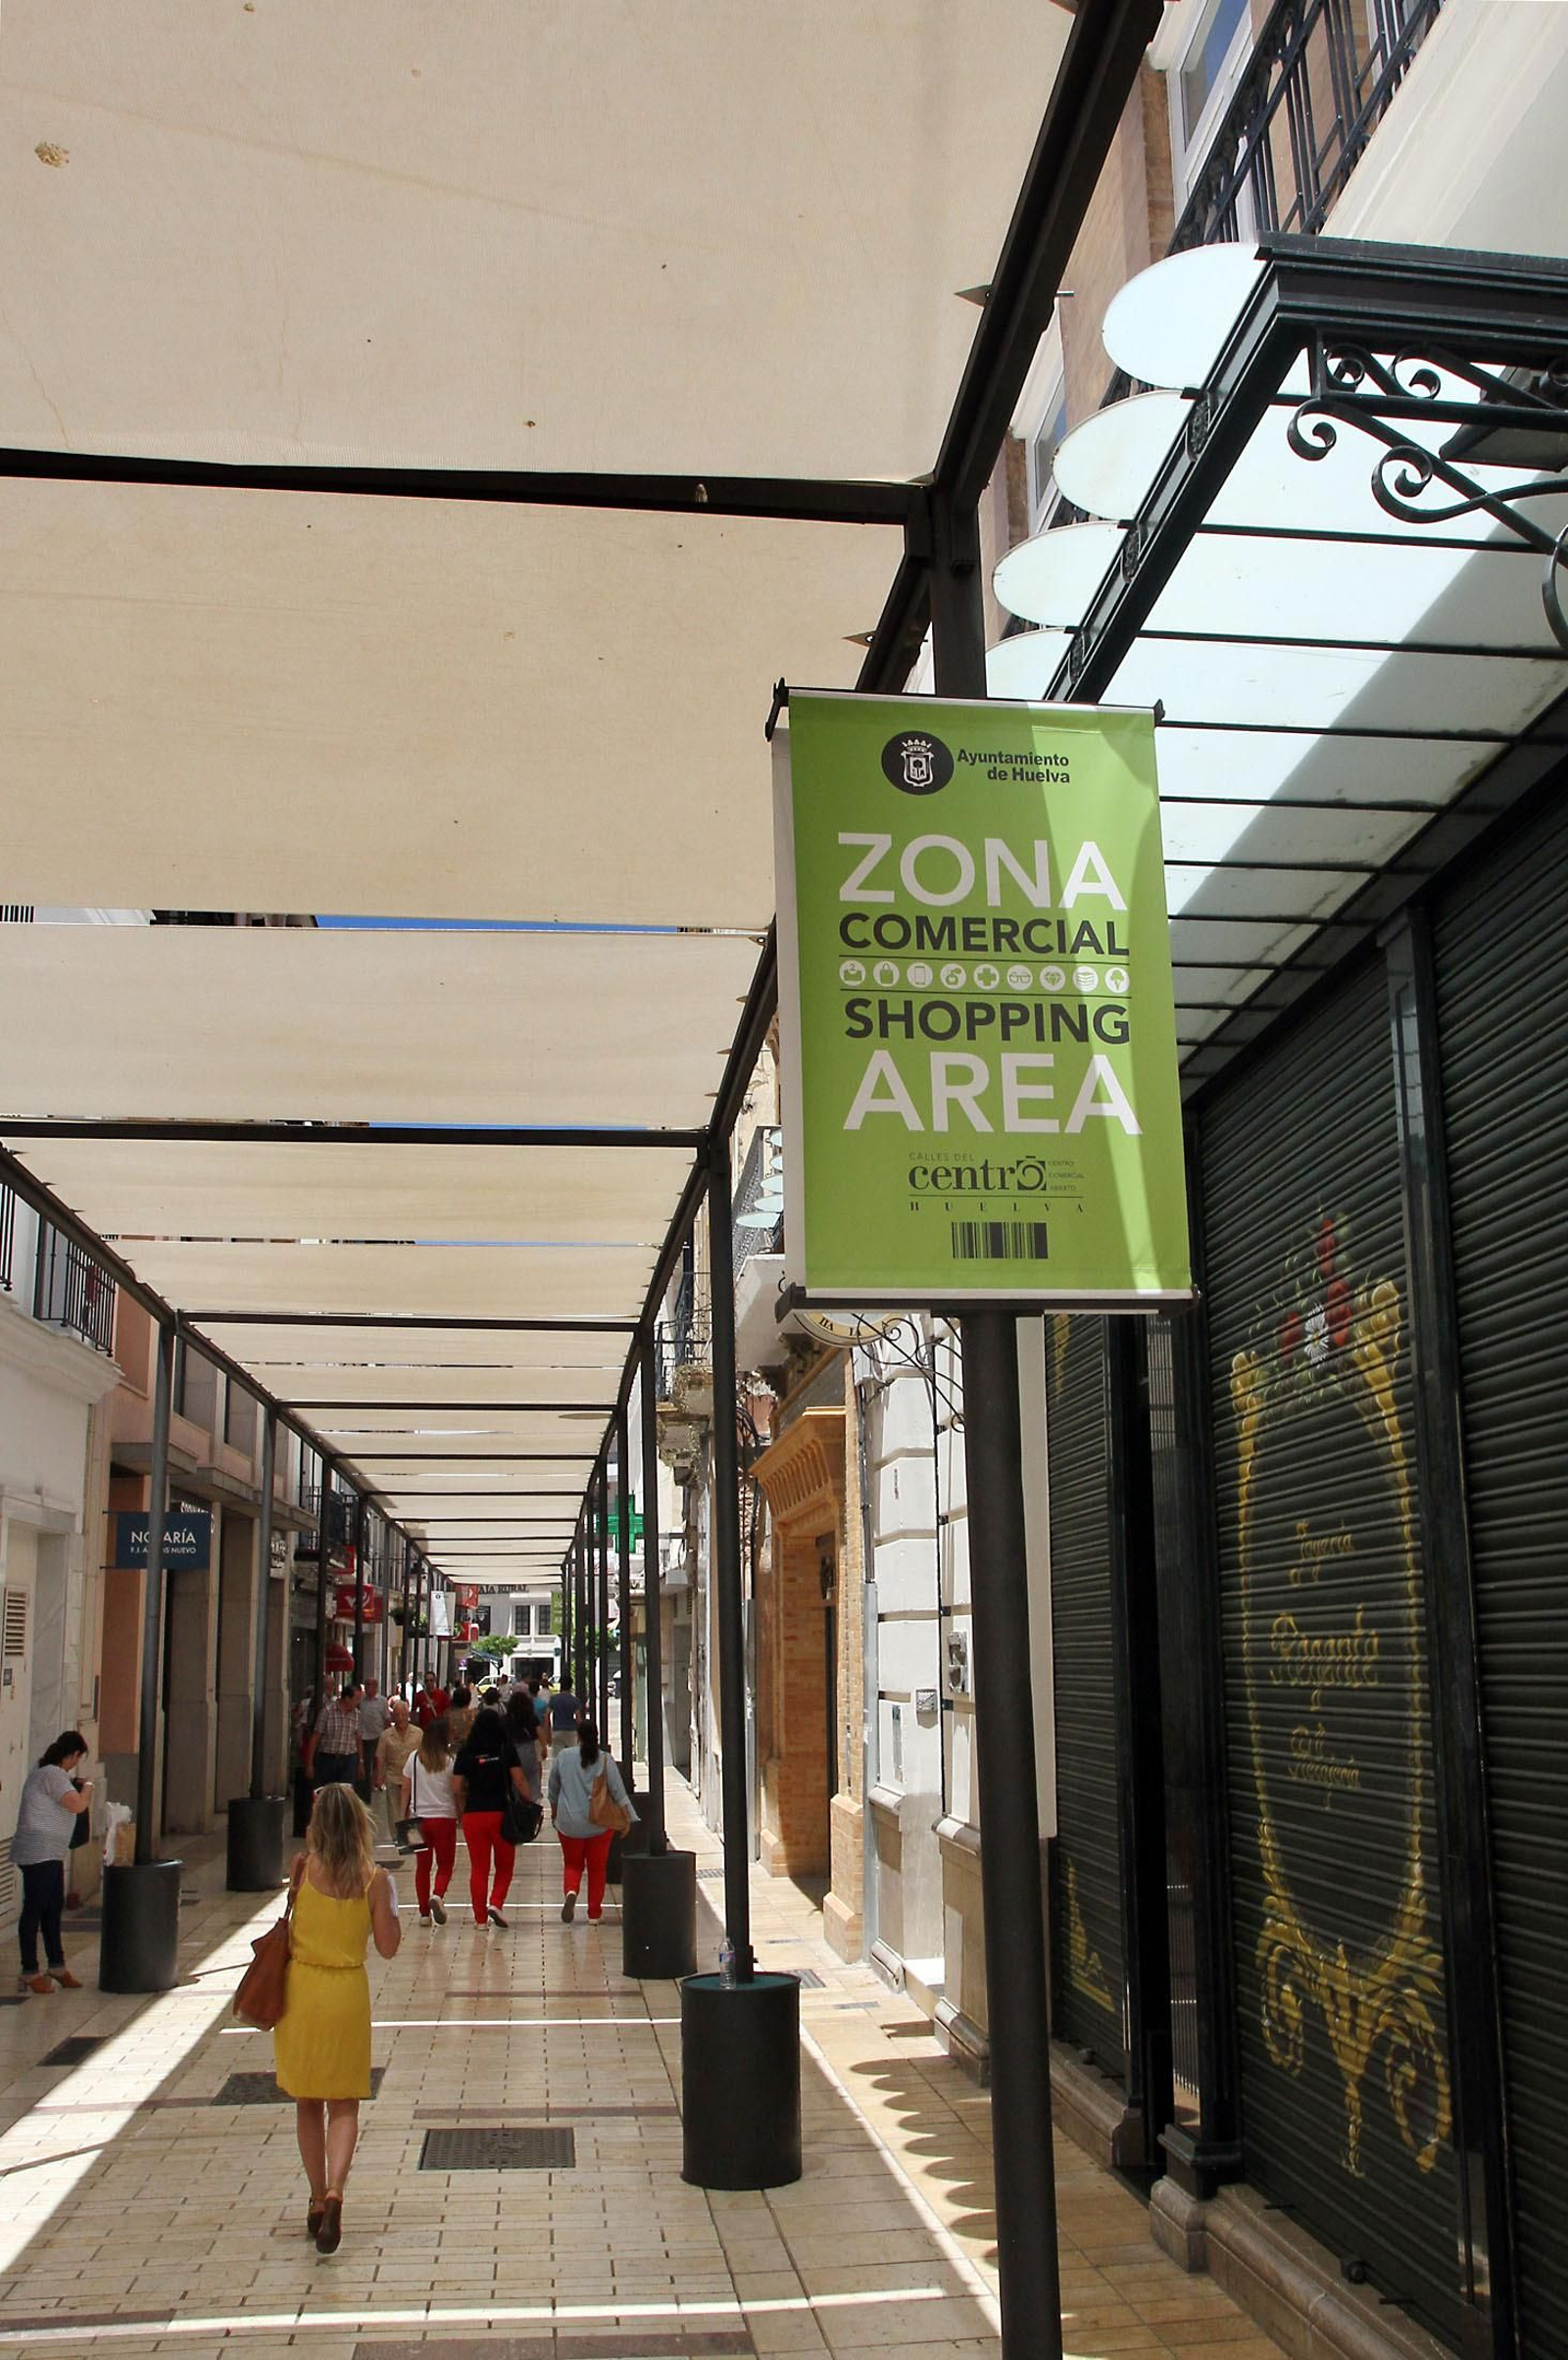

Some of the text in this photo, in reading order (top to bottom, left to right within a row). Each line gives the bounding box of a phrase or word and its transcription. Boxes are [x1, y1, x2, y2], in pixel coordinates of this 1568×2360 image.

[956, 749, 1070, 767] Ayuntamiento
[987, 766, 1071, 784] de Huelva
[838, 831, 1128, 910] ZONA
[839, 912, 1130, 957] COMERCIAL
[845, 998, 1130, 1045] SHOPPING
[843, 1050, 1144, 1135] AREA
[908, 1152, 975, 1162] CALLES DEL
[130, 1528, 197, 1544] NOARÍA
[497, 1584, 530, 1594] RURAL
